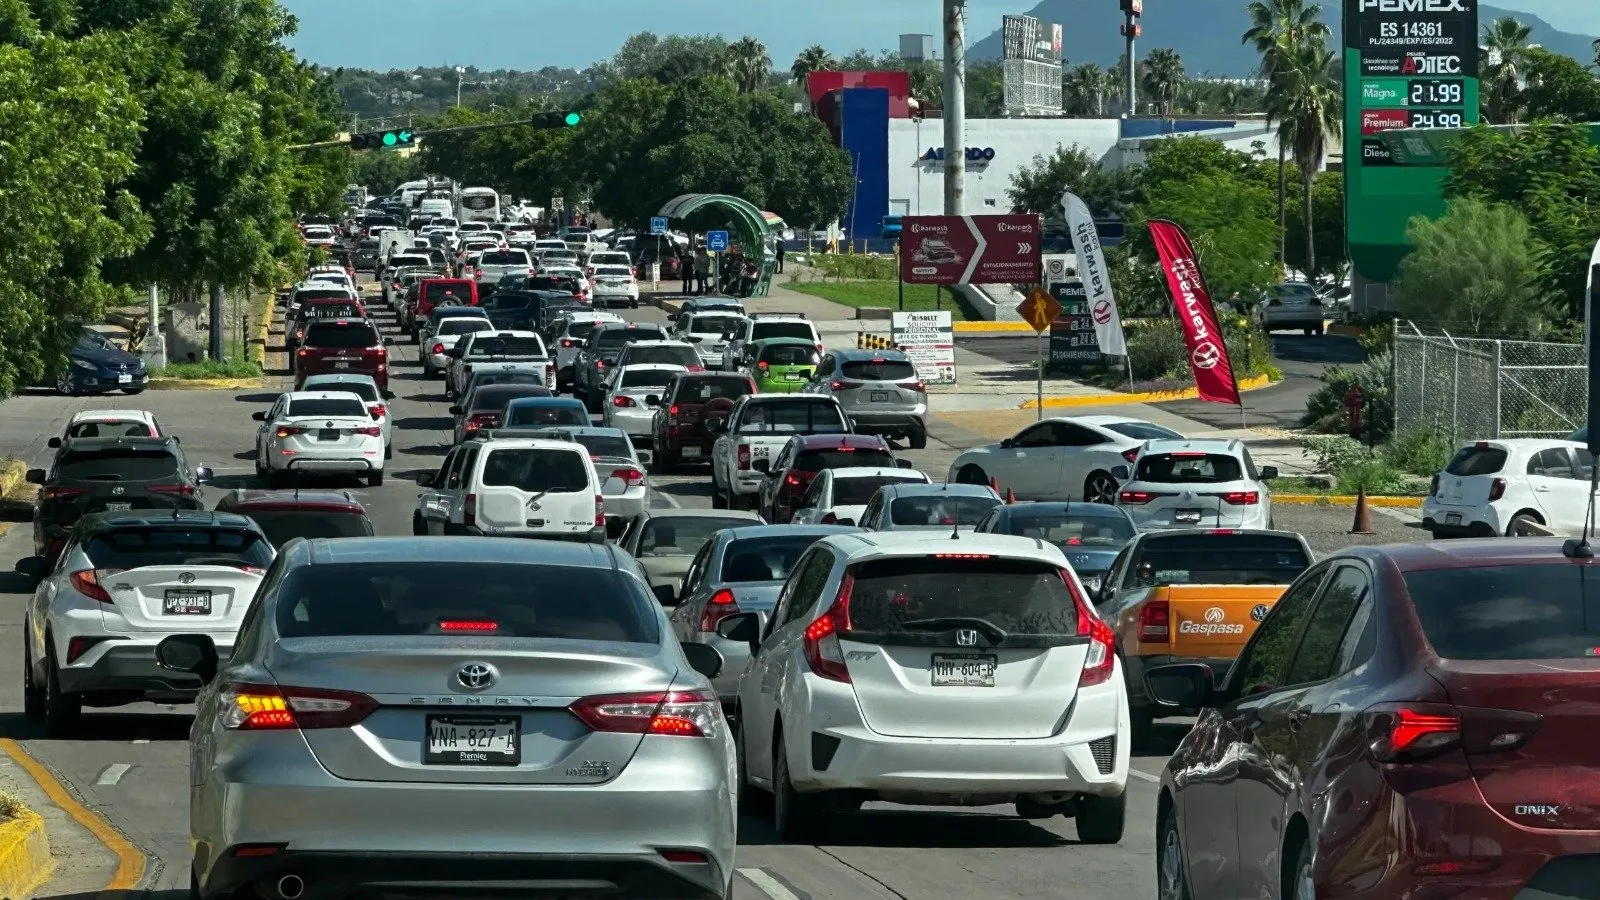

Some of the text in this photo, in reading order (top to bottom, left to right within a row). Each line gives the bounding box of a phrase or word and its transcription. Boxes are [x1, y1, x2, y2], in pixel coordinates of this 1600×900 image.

[1380, 22, 1442, 37] ES 14361
[1363, 88, 1396, 100] Magna
[1411, 84, 1461, 103] 21.99
[1363, 118, 1404, 128] Premium
[1077, 222, 1105, 298] karwash
[1060, 288, 1086, 296] PEME
[1172, 258, 1209, 341] karwash
[1179, 620, 1245, 636] Gaspasa
[935, 661, 994, 677] VHV-604-B
[430, 728, 515, 748] VNA-827-A
[460, 751, 487, 760] Premier
[1514, 805, 1559, 815] ONIX
